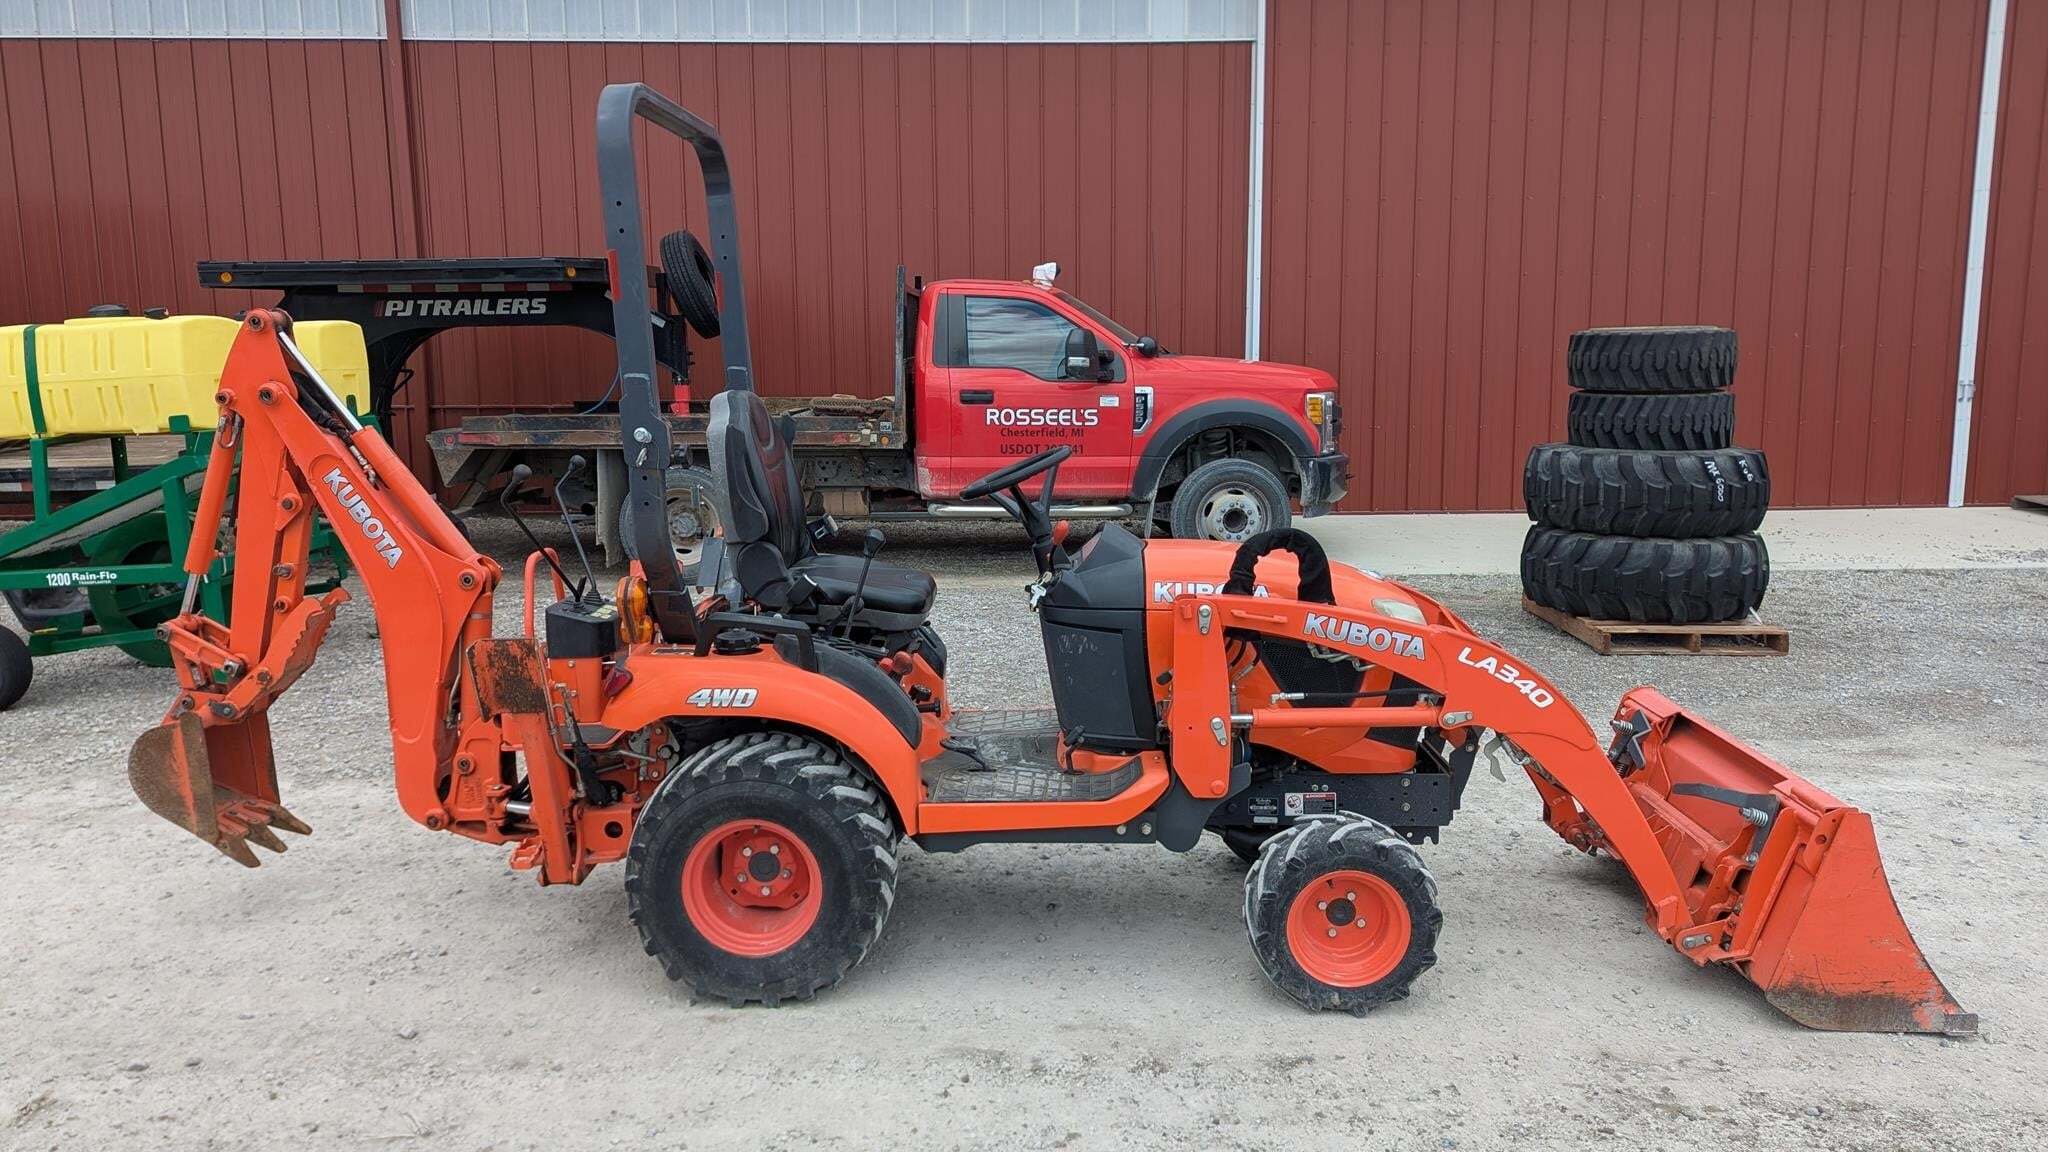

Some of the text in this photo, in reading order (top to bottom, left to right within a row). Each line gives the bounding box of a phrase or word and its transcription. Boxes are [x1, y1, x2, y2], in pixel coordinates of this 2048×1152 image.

[384, 298, 548, 317] PJ TRAILERS
[986, 408, 1099, 426] ROSSEEL'S
[1071, 428, 1084, 438] MI
[1001, 444, 1040, 455] USDOT
[322, 466, 404, 570] KUBOTA
[46, 571, 117, 586] 1200 Rain-Flo
[1303, 612, 1426, 661] KUBOTA
[1457, 646, 1555, 709] LA340
[685, 688, 759, 708] 4WD
